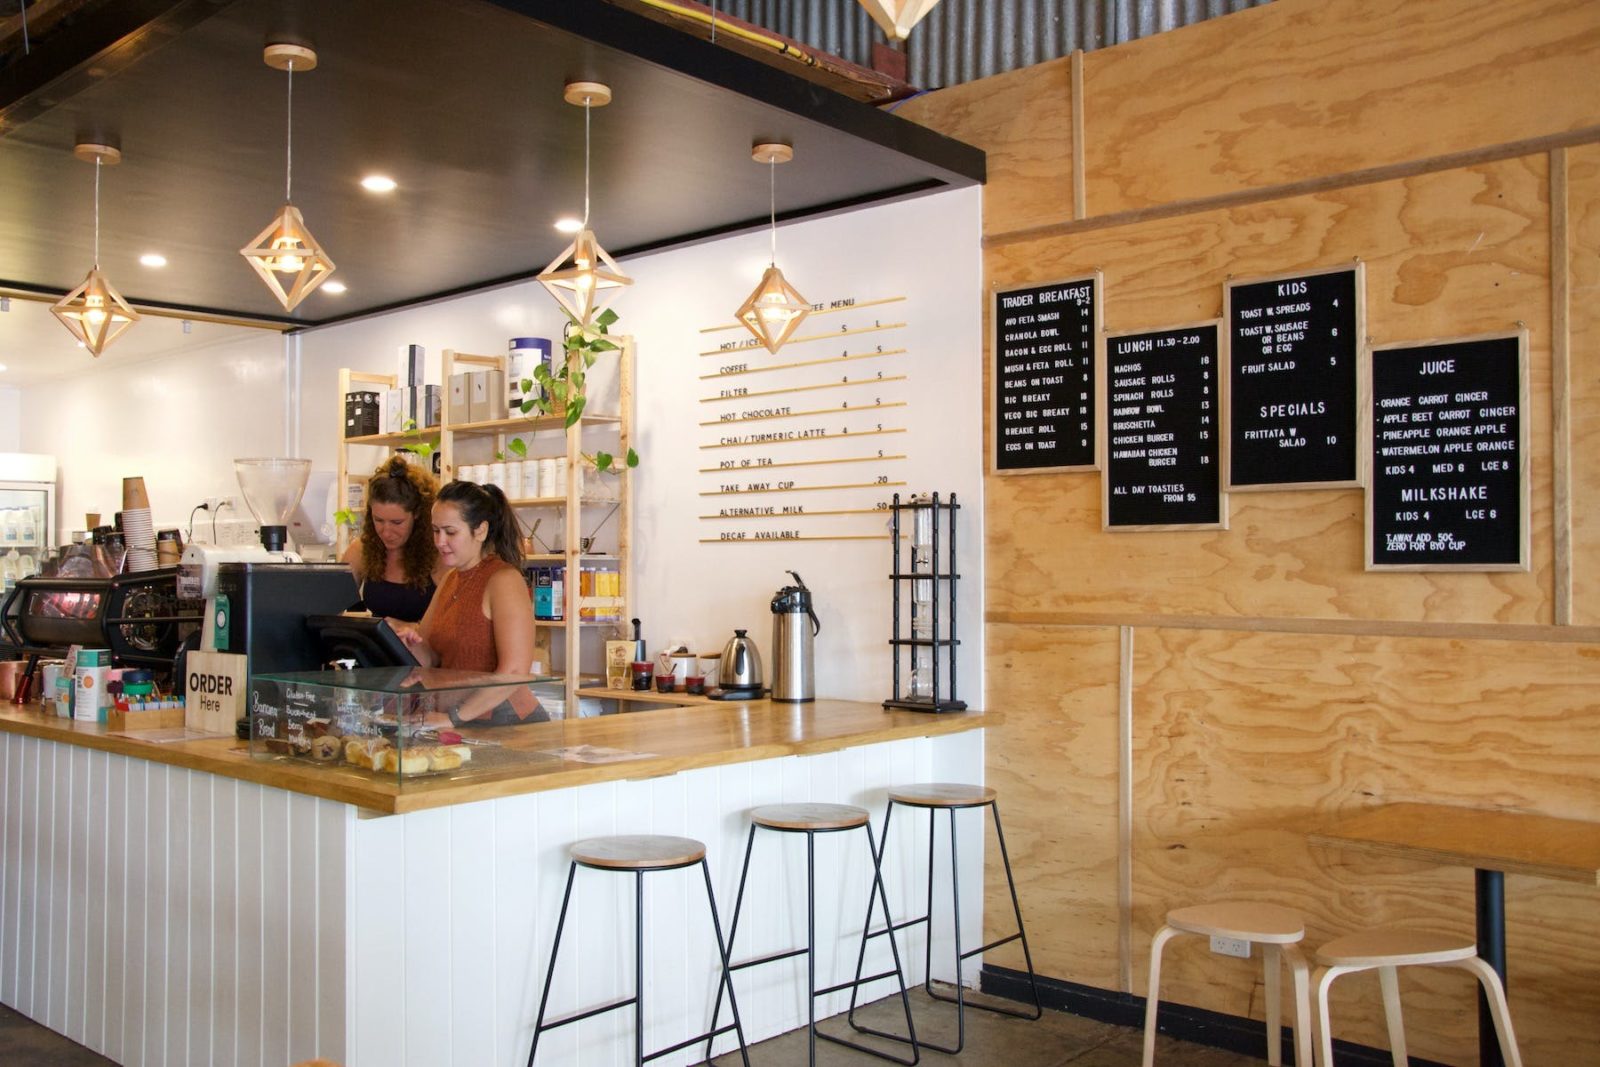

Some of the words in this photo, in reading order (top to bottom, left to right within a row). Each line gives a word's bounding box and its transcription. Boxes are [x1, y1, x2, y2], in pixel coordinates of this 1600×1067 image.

[1278, 282, 1307, 296] KIDS
[1002, 295, 1033, 308] TRADER
[1040, 286, 1090, 303] BREAKFAST
[831, 299, 855, 309] MENU
[1240, 309, 1262, 319] TOAST
[1276, 303, 1311, 315] SPREADS
[1333, 299, 1338, 307] 4
[1005, 318, 1016, 326] AVO
[1019, 316, 1034, 324] FETA
[1038, 312, 1059, 321] SMASH
[1081, 308, 1088, 316] 14
[842, 325, 847, 333] S
[1041, 329, 1059, 337] BOWL
[1240, 326, 1263, 336] TOAST
[1275, 321, 1309, 332] SAUSAGE
[1262, 336, 1271, 344] OR
[1277, 332, 1304, 342] BEANS
[720, 341, 736, 351] HOT
[1005, 348, 1028, 357] BACON
[1054, 343, 1072, 352] ROLL
[1118, 340, 1152, 354] LUNCH
[1157, 338, 1175, 347] 11.30
[1183, 336, 1200, 344] 2.00
[1262, 346, 1272, 354] OR
[720, 364, 748, 375] COFFEE
[843, 350, 847, 358] 4
[1004, 363, 1024, 373] MUSH
[1033, 362, 1049, 370] FETA
[1055, 359, 1073, 368] ROLL
[1114, 363, 1141, 373] NACHOS
[1242, 364, 1267, 374] FRUIT
[1268, 361, 1295, 372] SALAD
[1331, 357, 1336, 365] 5
[1420, 360, 1455, 375] JUICE
[1005, 379, 1027, 388] BEANS
[1042, 376, 1063, 385] TOAST
[1152, 374, 1175, 384] ROLLS
[721, 388, 748, 398] FILTER
[1023, 393, 1050, 402] BREAKY
[1114, 392, 1143, 402] SPINACH
[1151, 389, 1173, 399] ROLLS
[1381, 397, 1410, 407] ORANGE
[1419, 394, 1448, 404] CARROT
[720, 412, 736, 422] HOT
[742, 407, 791, 420] CHOCOLATE
[843, 401, 847, 409] 4
[1043, 408, 1069, 417] BREAKY
[1114, 406, 1140, 416] RAINBOW
[1146, 405, 1164, 414] BOWL
[1260, 402, 1325, 418] SPECIALS
[1113, 420, 1155, 430] BRUSCHETTA
[1202, 416, 1209, 424] 14
[1383, 414, 1408, 424] APPLE
[1412, 412, 1433, 422] BEET
[1439, 410, 1471, 420] CARROT
[798, 429, 825, 438] LATTE
[843, 427, 847, 435] 4
[877, 424, 882, 432] 5
[1039, 425, 1055, 433] ROLL
[1245, 429, 1284, 439] FRITTATA
[1383, 429, 1430, 440] PINEAPPLE
[1436, 426, 1471, 436] ORANGE
[1474, 424, 1506, 434] APPLE
[1113, 436, 1143, 444] CHICKEN
[1147, 433, 1174, 442] BURGER
[1200, 431, 1208, 439] 15
[1279, 438, 1306, 447] SALAD
[1327, 436, 1336, 445] 10
[1038, 441, 1056, 449] TOAST
[1382, 445, 1439, 456] WATERMELON
[1444, 443, 1472, 453] APPLE
[1477, 441, 1515, 450] ORANGE
[758, 458, 773, 466] TEA
[878, 450, 883, 458] 5
[1113, 449, 1145, 459] HAWAIIAN
[1149, 448, 1177, 457] CHICKEN
[1149, 458, 1176, 466] BURGER
[1386, 466, 1405, 475] KIDS
[1409, 465, 1414, 474] 4
[1433, 464, 1453, 473] MED
[720, 485, 739, 493] TAKE
[748, 483, 770, 491] AWAY
[778, 481, 795, 489] CUP
[1148, 484, 1184, 493] TOASTIES
[1164, 494, 1183, 502] FROM
[1402, 486, 1487, 502] MILKSHAKE
[719, 507, 774, 516] ALTERNATIVE
[783, 506, 803, 514] MILK
[1396, 512, 1418, 521] KIDS
[1424, 511, 1430, 520] 4
[721, 532, 746, 540] DECAF
[755, 531, 799, 539] AVAILABLE
[1416, 533, 1431, 542] ADD
[1387, 542, 1406, 551] ZERO
[1410, 542, 1425, 550] FOR
[1430, 541, 1445, 550] BYO
[1449, 541, 1466, 550] CUP
[190, 672, 232, 696] ORDER
[200, 695, 220, 712] Here
